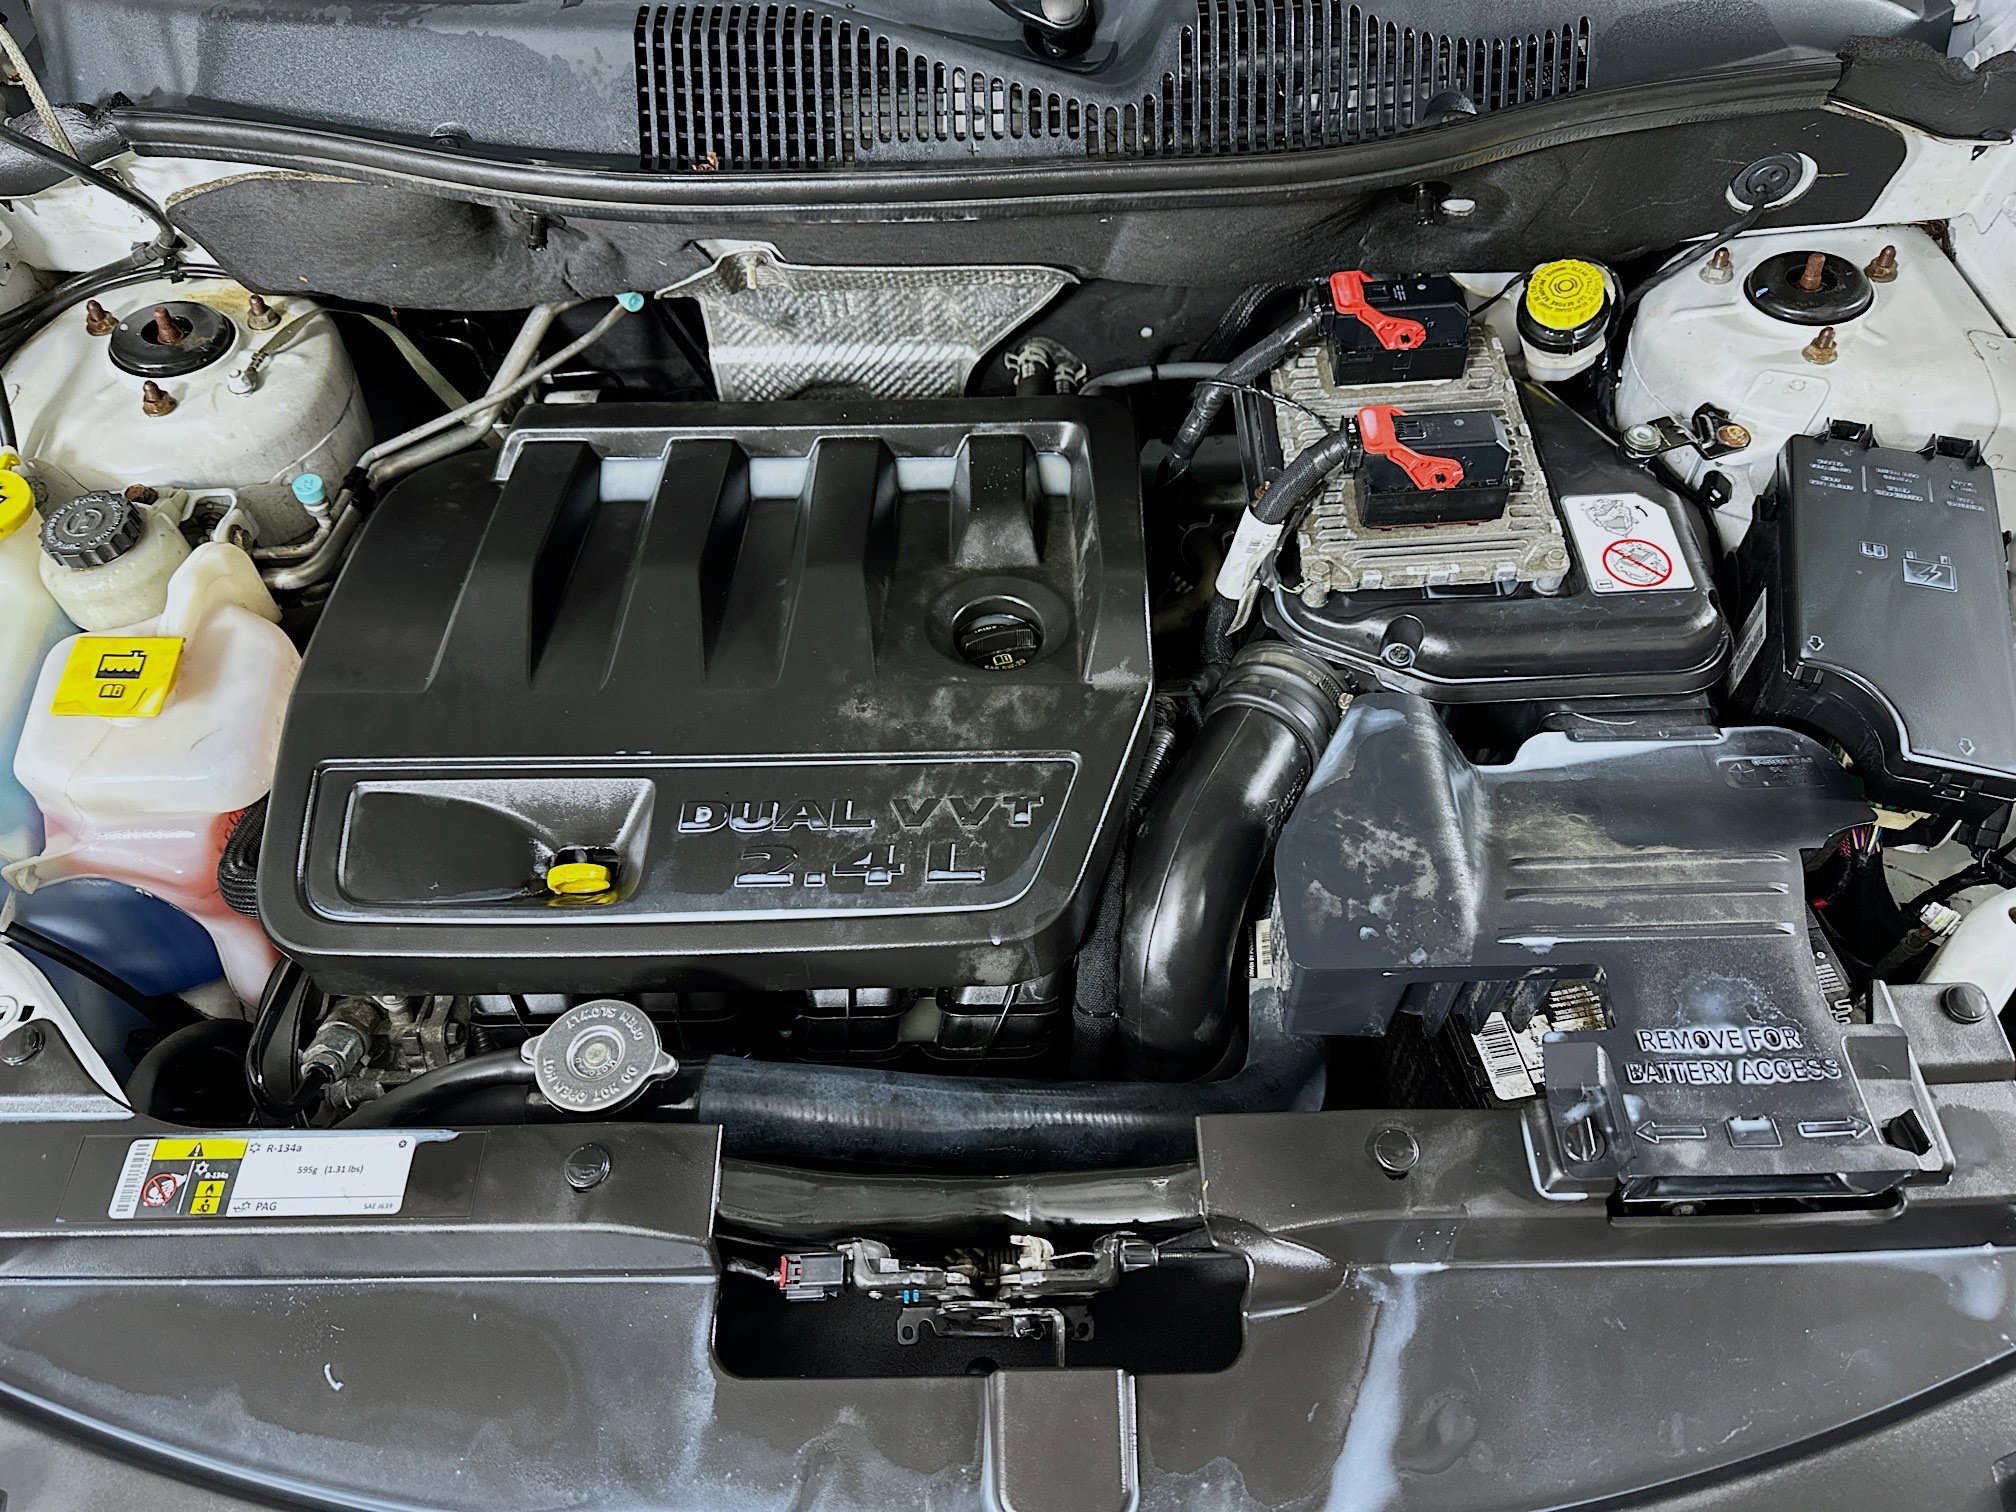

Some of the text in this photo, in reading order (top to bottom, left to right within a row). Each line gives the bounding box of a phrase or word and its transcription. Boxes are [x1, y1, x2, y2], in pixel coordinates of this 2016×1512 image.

[678, 796, 1044, 833] DUAL VVT
[734, 844, 986, 887] 2.4L
[565, 1006, 617, 1030] SLOWLY
[1636, 1027, 1803, 1052] REMOVE FOR
[543, 1057, 638, 1103] DO NOT OPEN HOT
[1626, 1058, 1842, 1084] BATTERY ACCESS
[266, 1143, 303, 1153] R-134a
[297, 1164, 364, 1175] 595g (1.31 lbs)
[255, 1202, 278, 1211] PAG
[377, 1202, 394, 1210] J639
